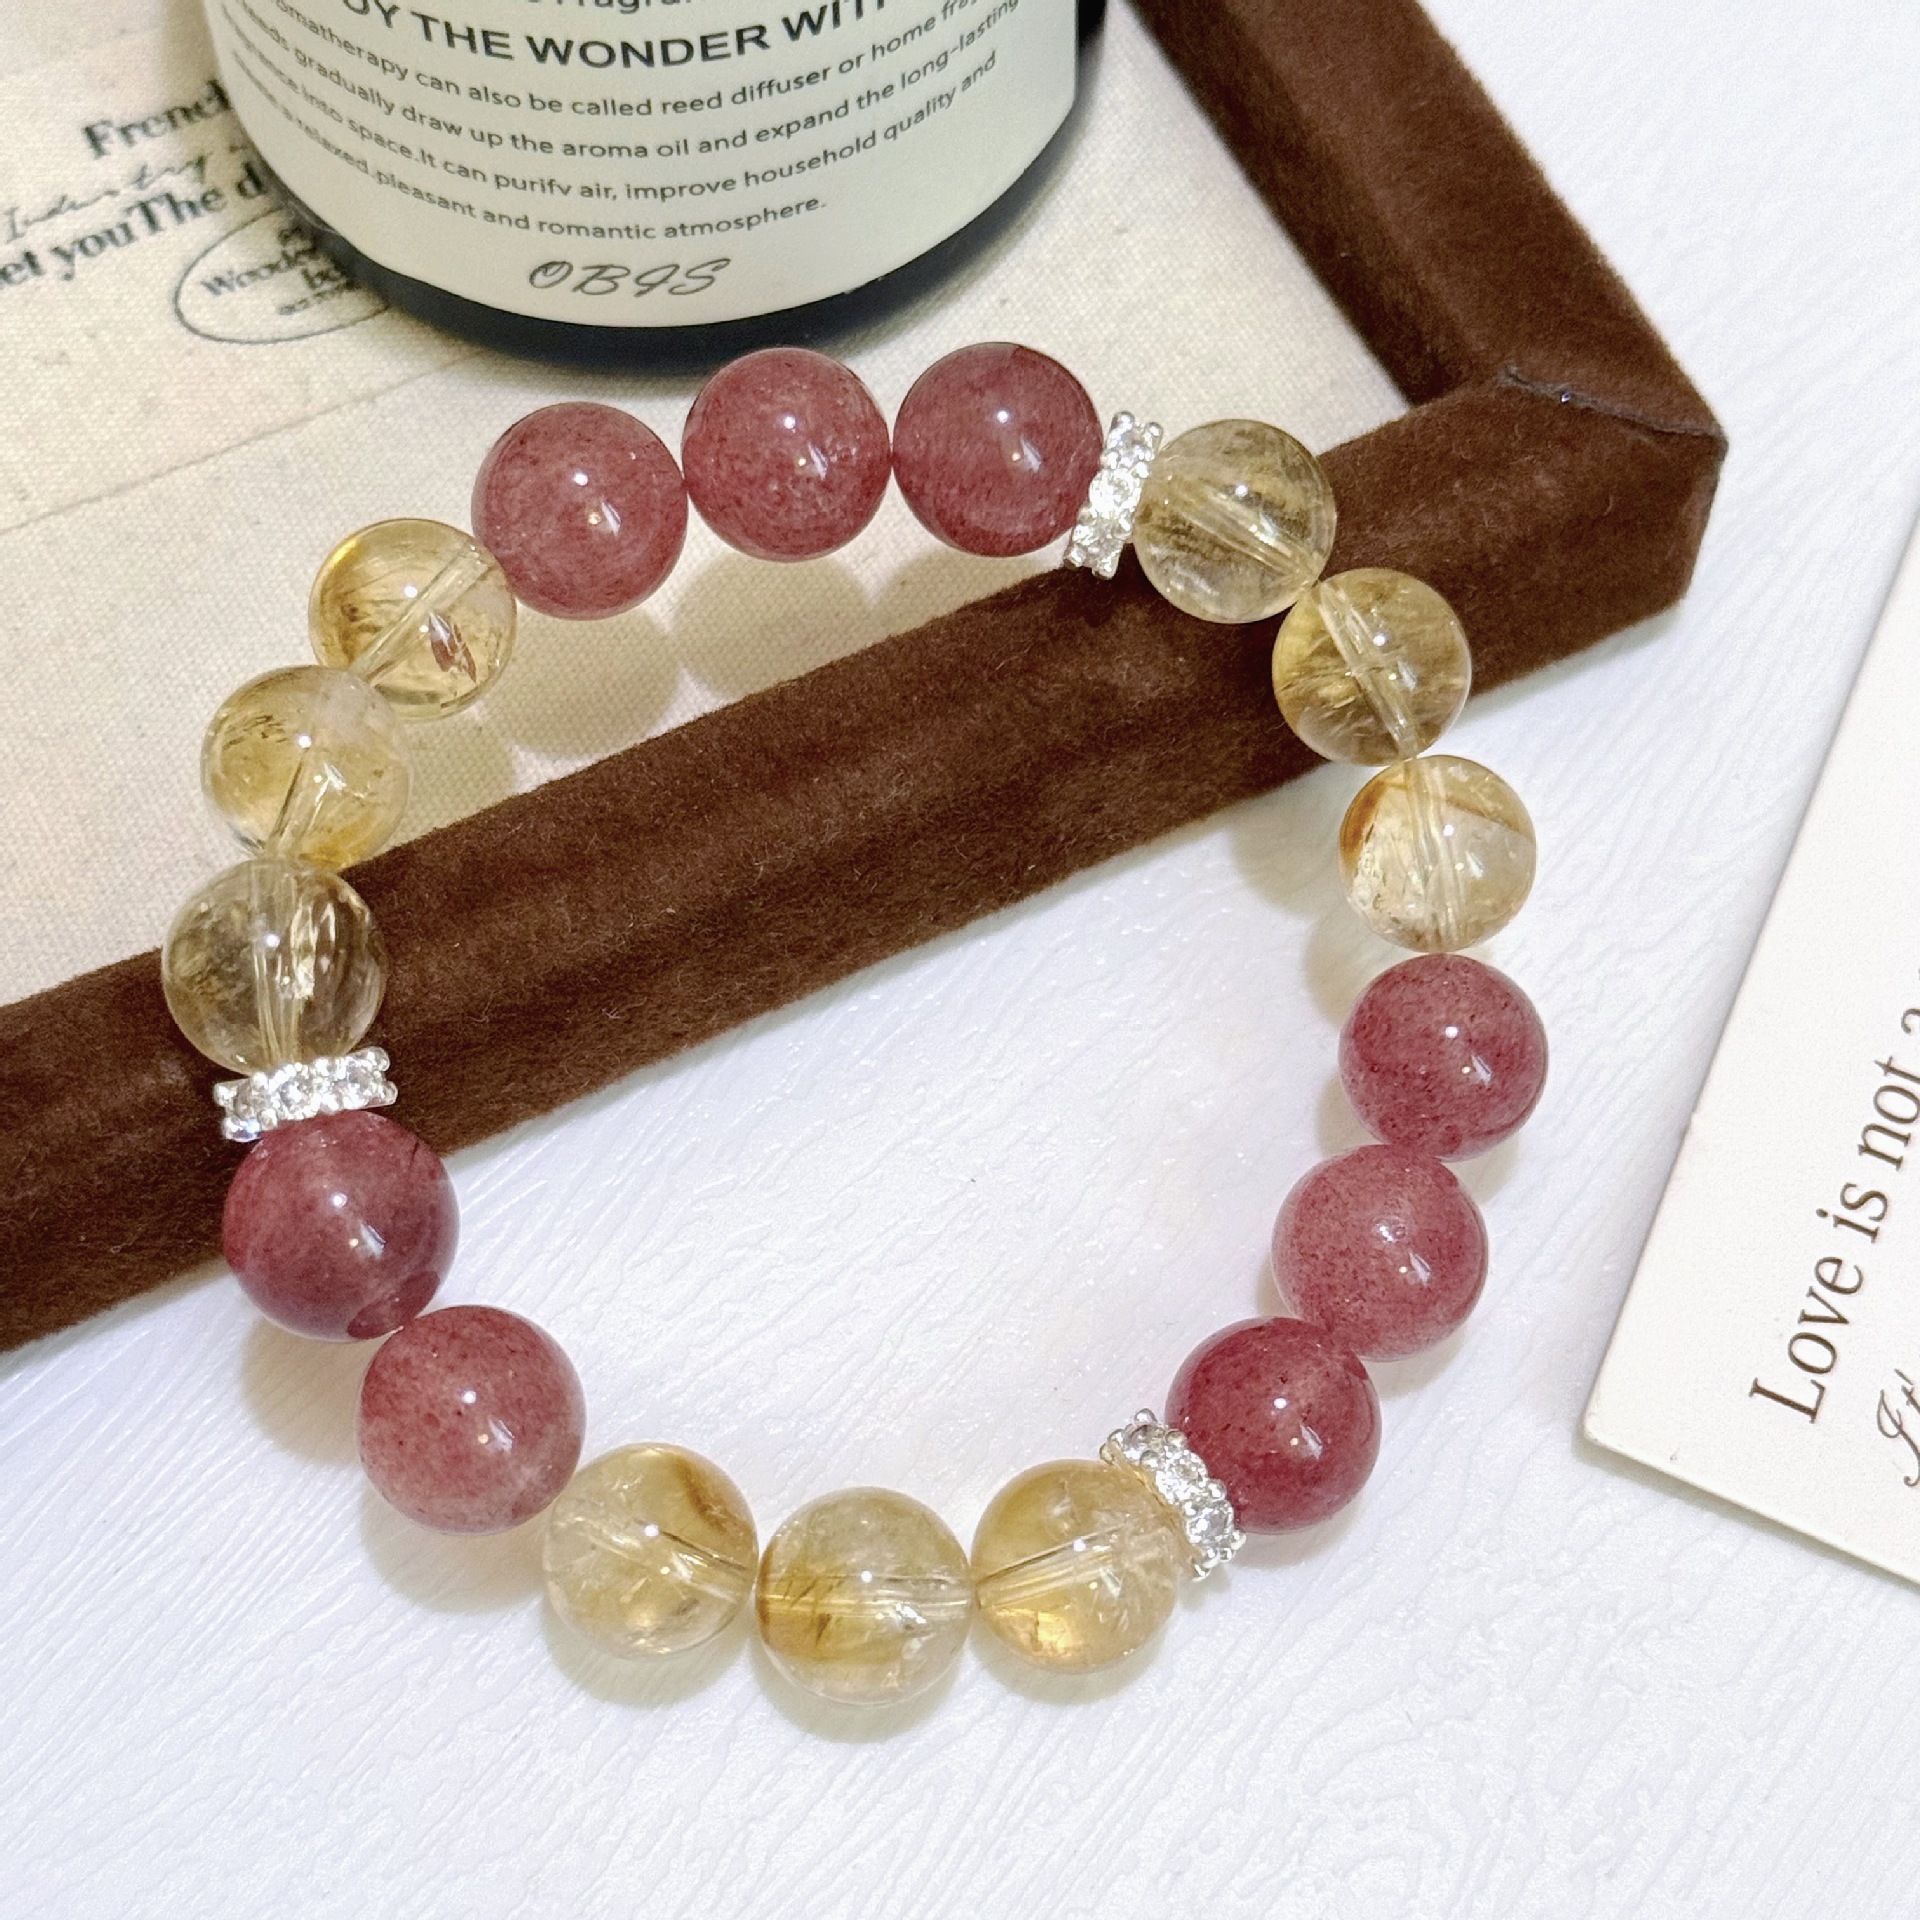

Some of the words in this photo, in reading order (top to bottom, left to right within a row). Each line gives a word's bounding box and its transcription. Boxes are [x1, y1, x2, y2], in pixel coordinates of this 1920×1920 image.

[294, 47, 395, 116] gradually
[402, 106, 462, 137] draw
[470, 129, 503, 149] up
[509, 133, 554, 154] the
[562, 142, 648, 158] aroma
[656, 138, 690, 157] oil
[698, 130, 747, 154] and
[755, 99, 849, 140] expand
[855, 83, 895, 110] the
[901, 0, 1019, 90] long-lasting
[410, 11, 514, 61] THE
[524, 24, 771, 69] WONDER
[781, 0, 885, 42] WIT
[416, 70, 461, 95] can
[468, 86, 521, 109] also
[528, 92, 563, 113] be
[571, 99, 653, 117] called
[661, 91, 722, 114] reed
[731, 66, 831, 103] diffuser
[838, 53, 865, 74] or
[872, 16, 937, 61] home
[443, 160, 488, 183] can
[580, 182, 617, 200] air,
[625, 177, 737, 202] improve
[744, 131, 877, 188] household
[883, 86, 957, 141] quality
[961, 50, 996, 92] and
[482, 209, 530, 230] and
[538, 221, 656, 239] romantic
[664, 196, 827, 239] atmosphere.
[1748, 1256, 1864, 1424] Love
[1816, 1182, 1889, 1244] is
[1857, 1055, 1920, 1171] not
